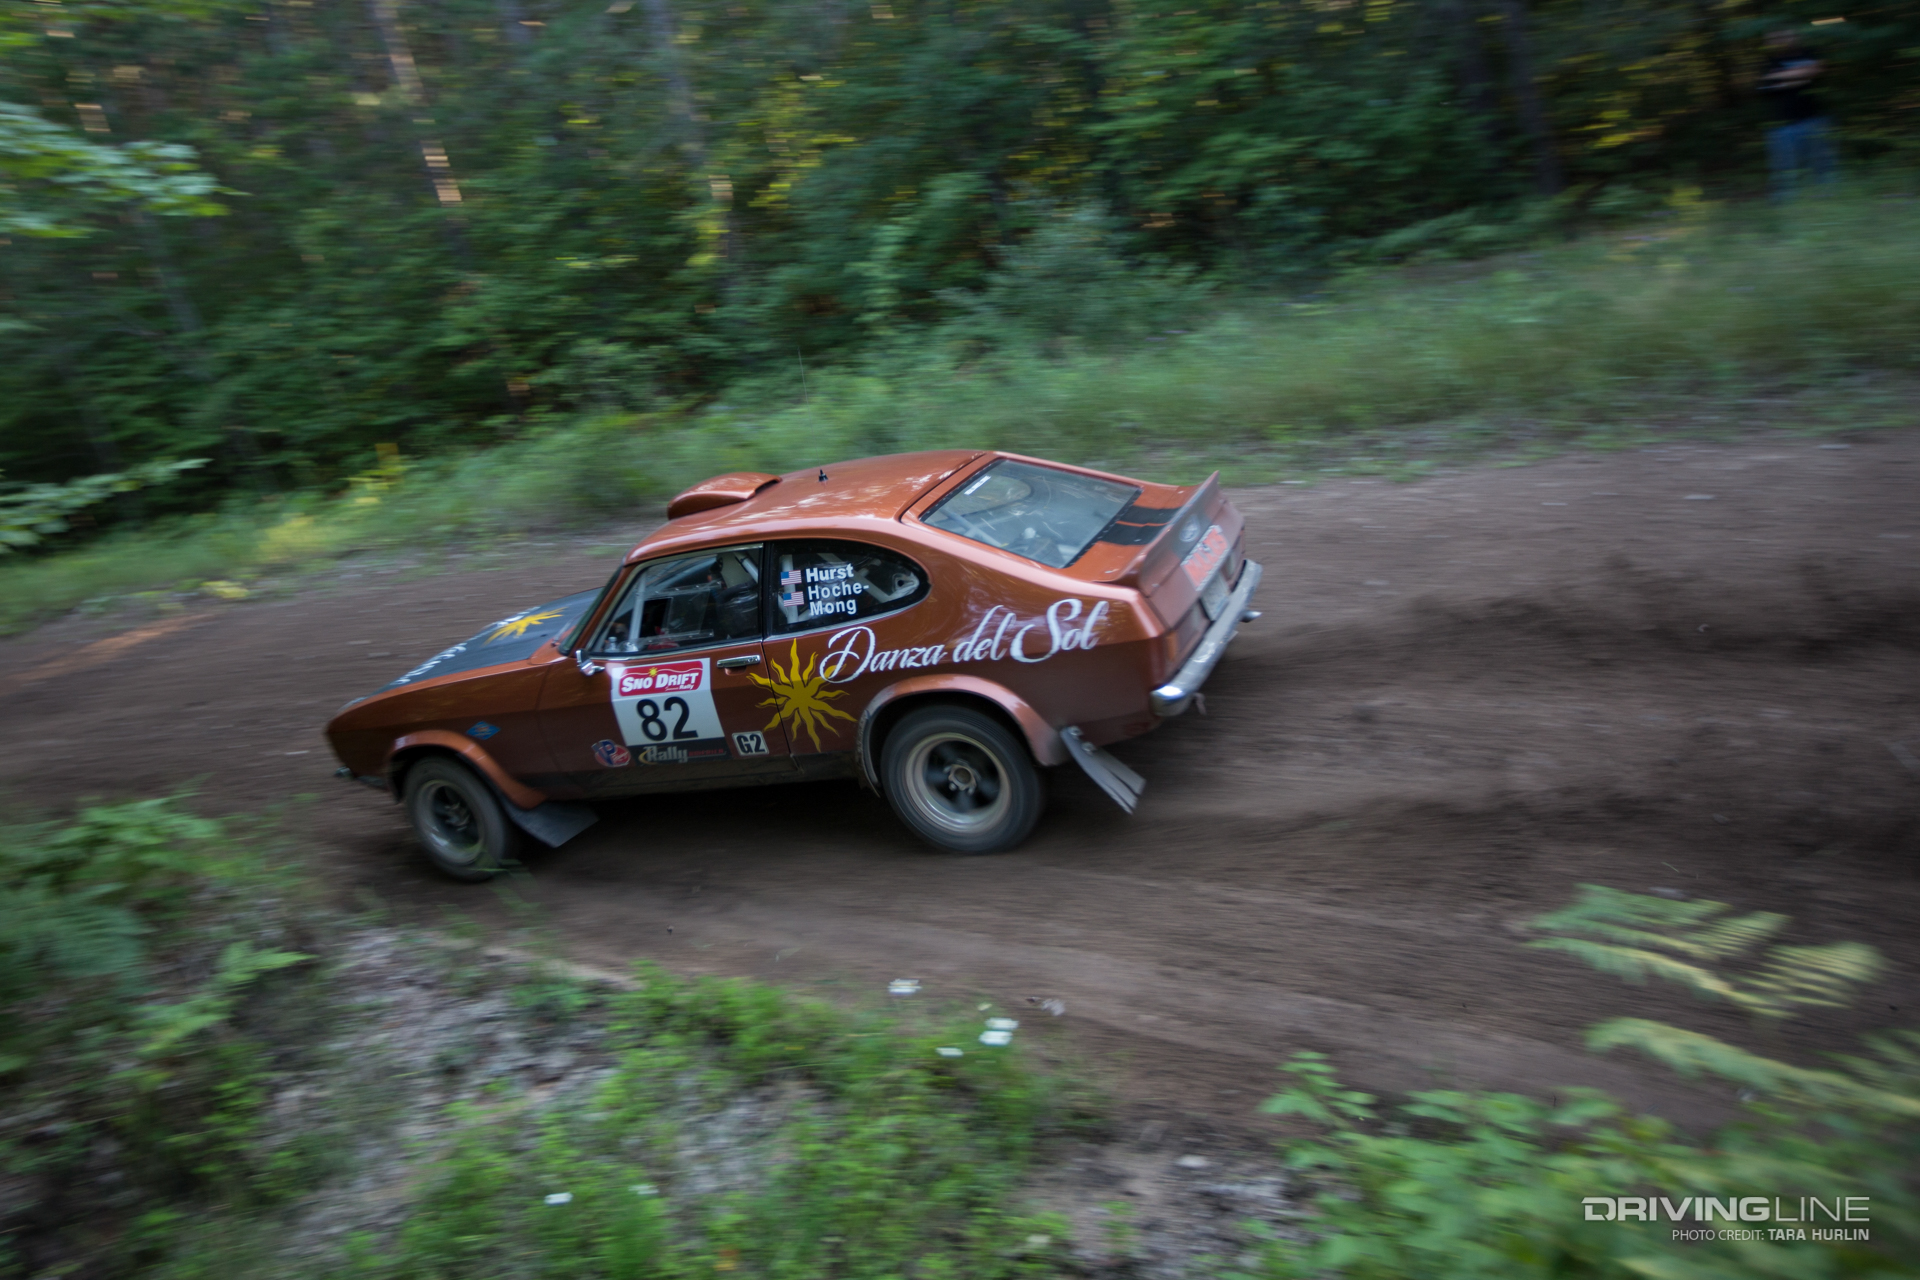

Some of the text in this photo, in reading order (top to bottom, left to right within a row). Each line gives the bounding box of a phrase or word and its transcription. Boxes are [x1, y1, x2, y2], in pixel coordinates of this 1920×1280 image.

[805, 563, 854, 583] Hurst
[807, 581, 870, 600] Hoche-
[809, 599, 857, 616] Mong
[819, 598, 1109, 683] Danza del Sol
[621, 672, 699, 693] SNO DRIFT
[636, 696, 699, 741] 82
[736, 733, 766, 754] G2
[643, 745, 688, 763] Rally
